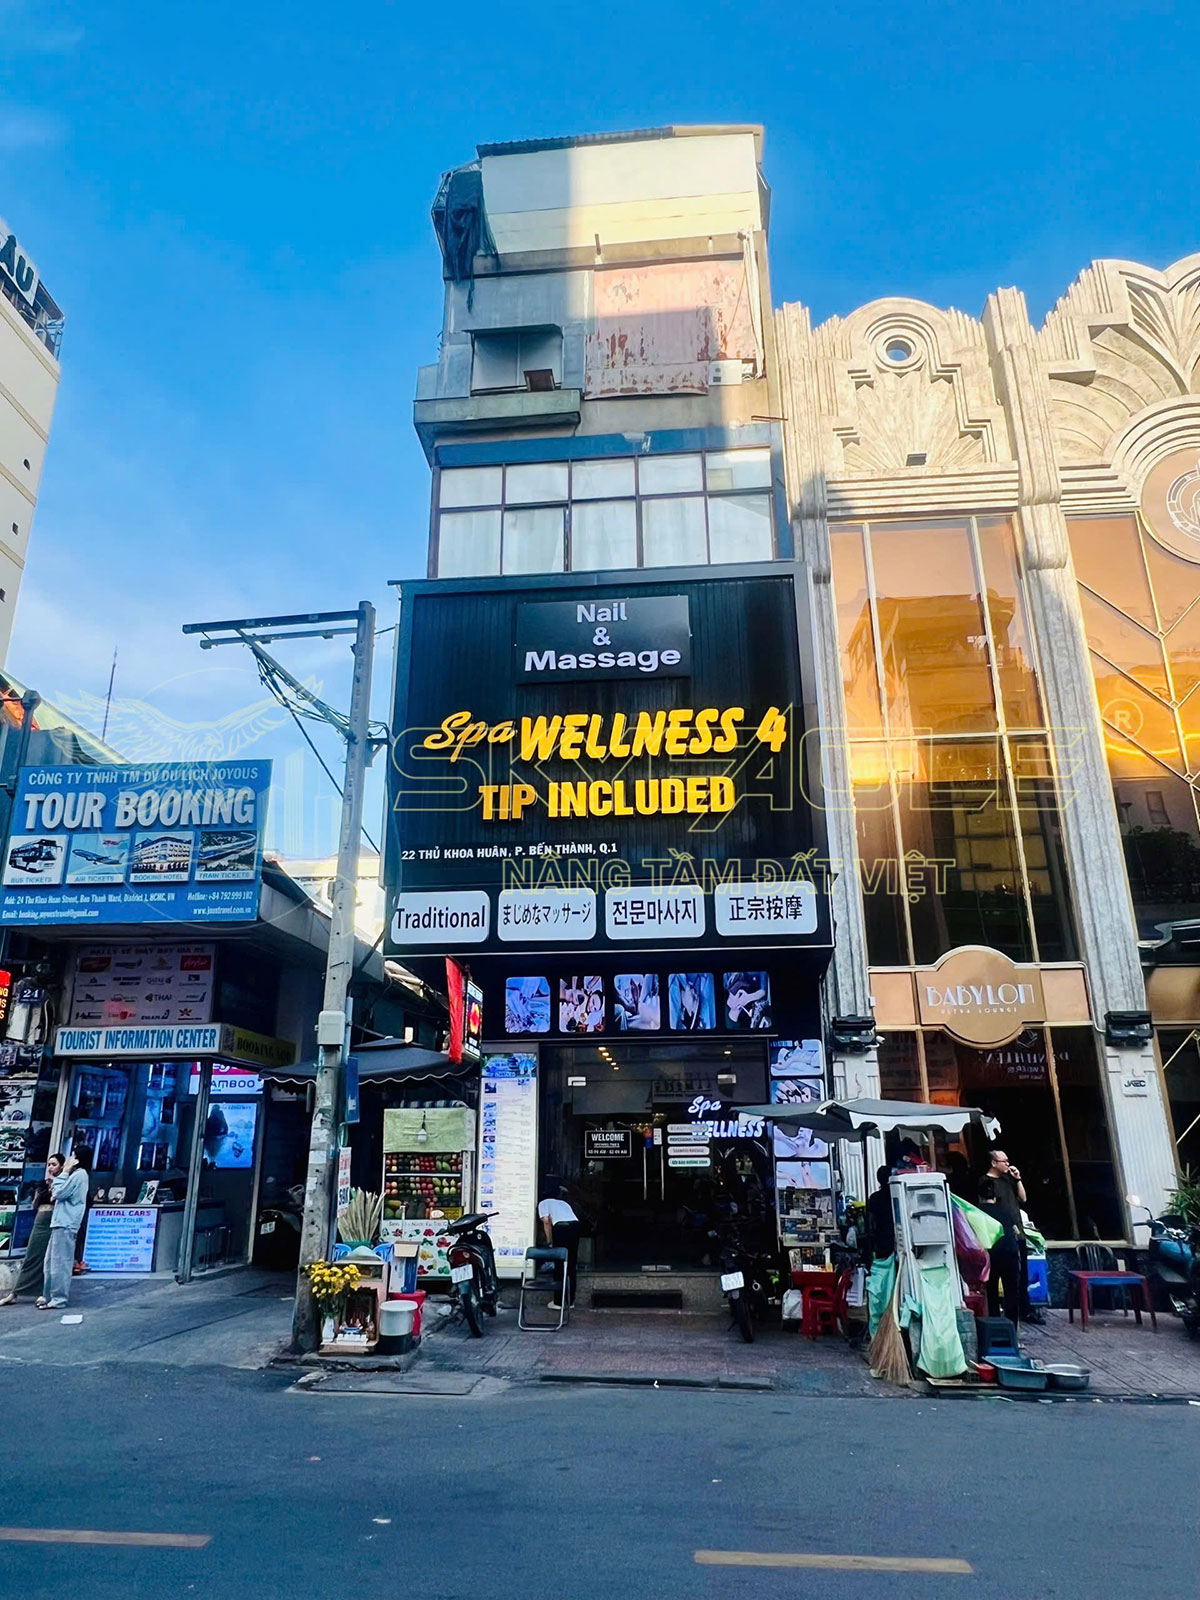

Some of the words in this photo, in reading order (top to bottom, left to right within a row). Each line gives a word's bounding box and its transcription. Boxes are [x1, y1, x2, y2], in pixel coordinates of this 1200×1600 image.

[576, 602, 627, 623] Nail
[592, 627, 611, 646] &
[524, 650, 681, 672] Massage
[423, 711, 516, 763] Spa
[521, 707, 745, 761] WELLNESS
[756, 706, 787, 752] 4
[28, 769, 63, 785] CÔNG
[67, 773, 83, 784] TY
[86, 771, 118, 783] TNHH
[122, 771, 140, 782] TM
[143, 770, 161, 782] DV
[162, 770, 179, 782] DU
[211, 767, 259, 781] JOYOUS
[24, 791, 107, 829] TOUR
[115, 786, 257, 828] BOOKING
[478, 784, 537, 820] TIP
[548, 776, 736, 819] INCLUDED
[401, 850, 416, 860] 22
[418, 846, 441, 860] THỦ
[444, 849, 474, 859] KHOA
[477, 845, 512, 859] HUÂN,
[515, 846, 526, 856] P.
[529, 842, 552, 856] BẾN
[556, 842, 596, 856] THÀNH,
[599, 842, 618, 854] Q.1
[134, 873, 161, 881] BOOKING
[397, 905, 486, 929] Traditional
[503, 901, 593, 925] まじめなマッサージ
[612, 898, 698, 926] 전문마사지
[729, 895, 803, 921] 正宗按摩
[22, 989, 39, 998] 24
[59, 1030, 102, 1050] TOURIST
[104, 1029, 174, 1049] INFORMATION
[176, 1028, 217, 1048] CENTER
[211, 1079, 256, 1089] AMBOO
[687, 1096, 721, 1118] Spa
[591, 1133, 625, 1141] WELCOME
